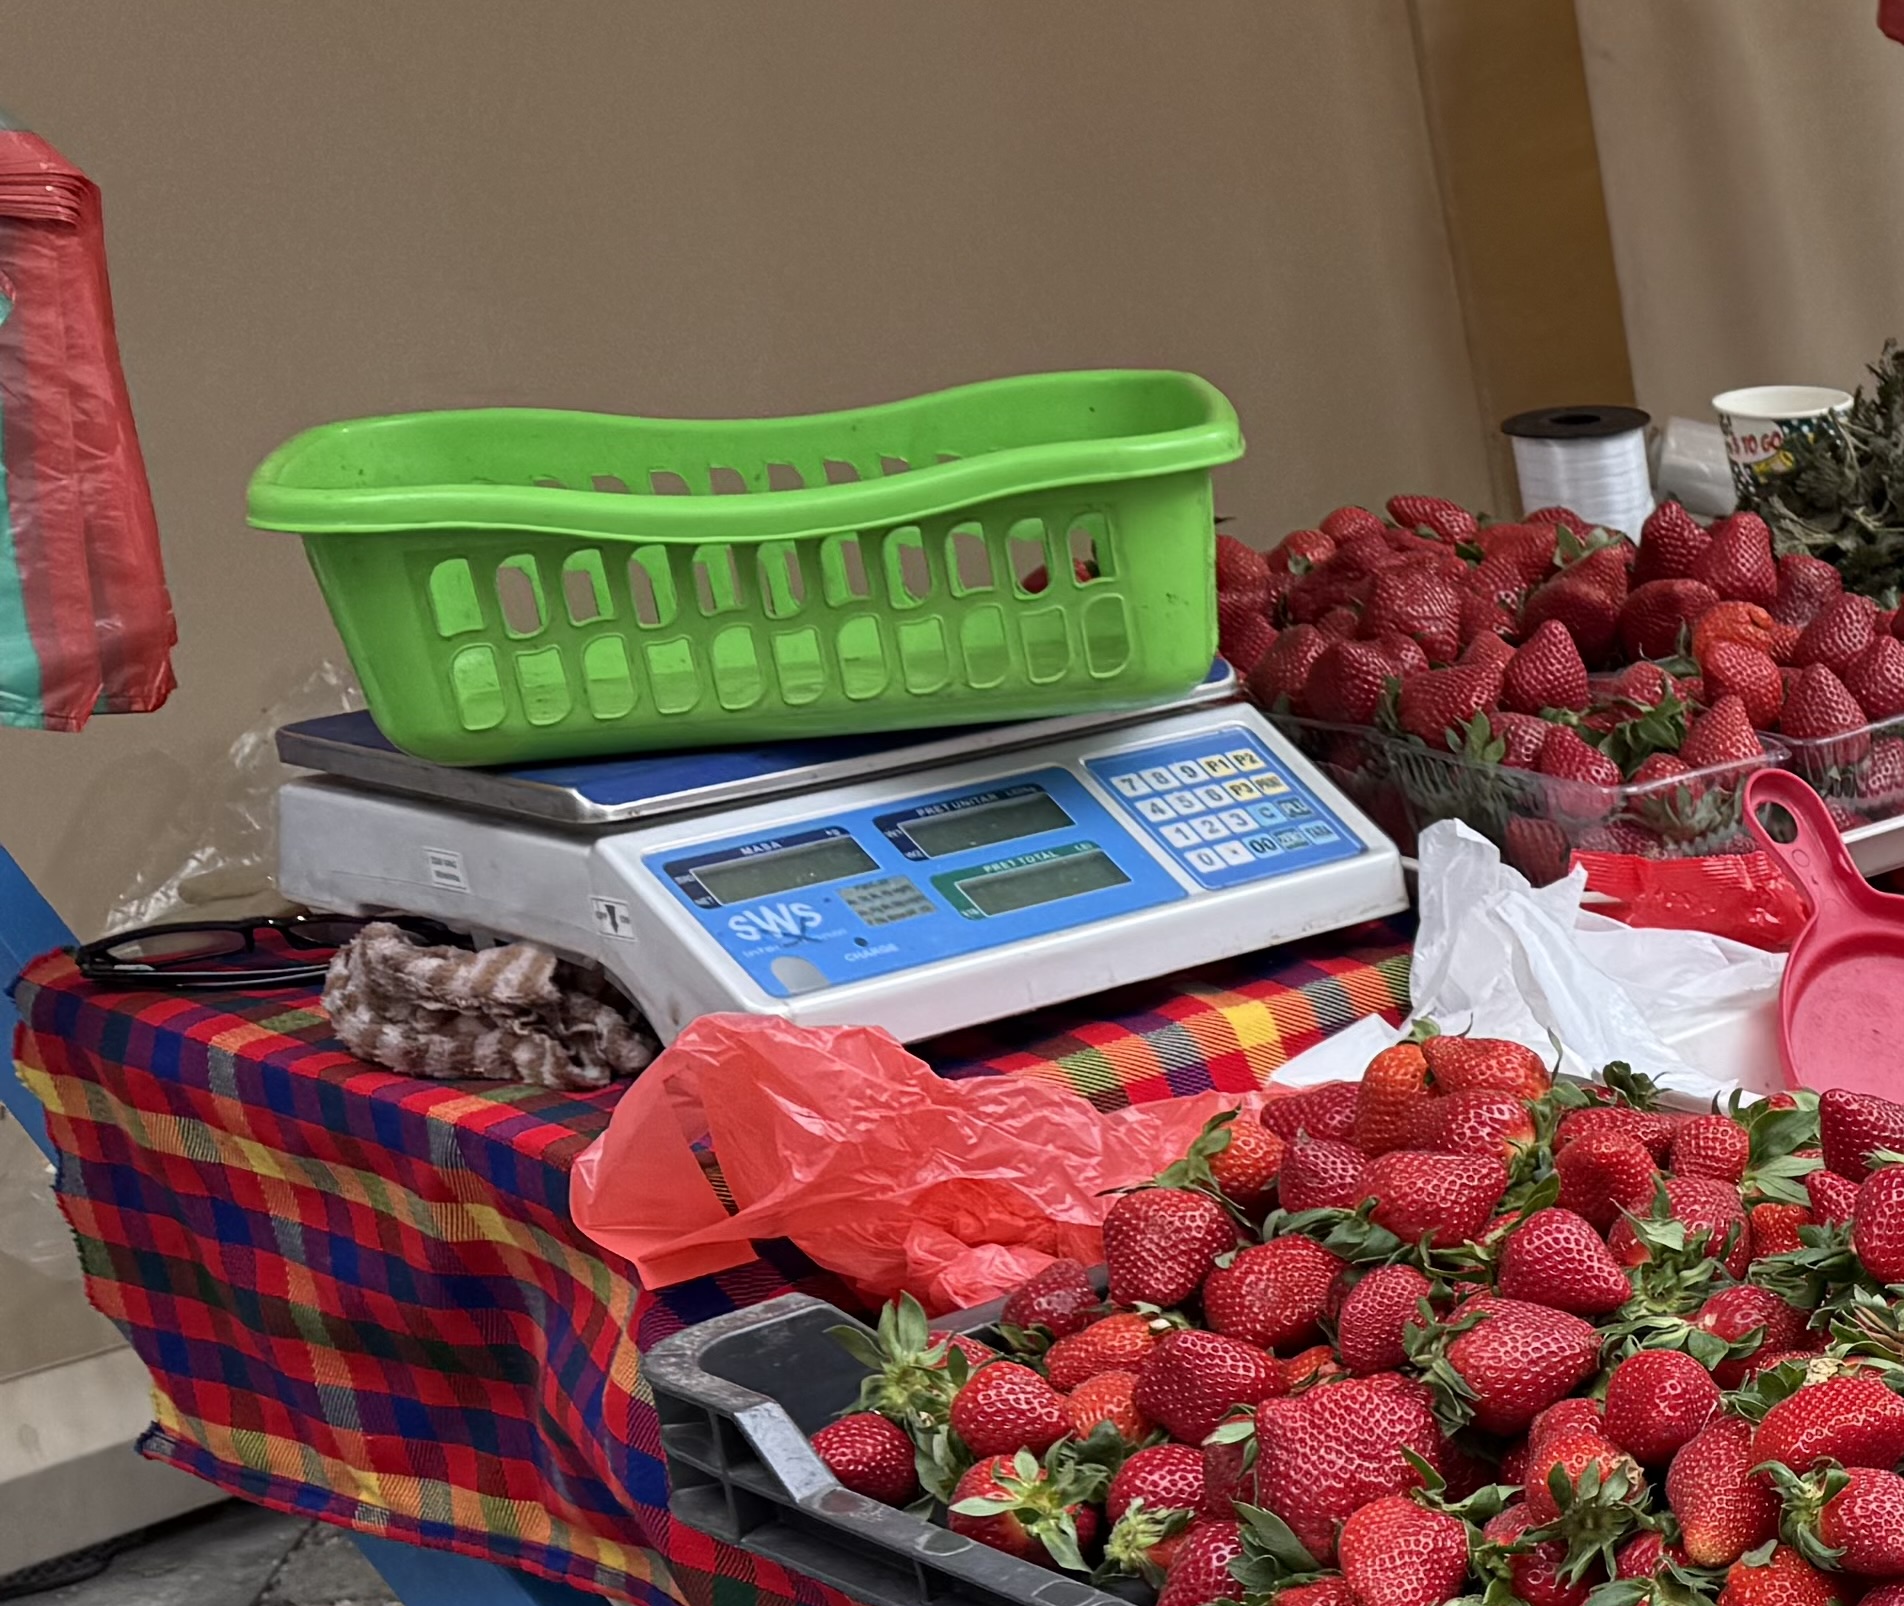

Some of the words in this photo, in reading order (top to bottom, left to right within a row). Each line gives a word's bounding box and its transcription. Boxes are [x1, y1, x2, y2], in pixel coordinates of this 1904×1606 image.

[1741, 433, 1758, 455] TO
[1761, 430, 1782, 453] GO
[1119, 778, 1137, 792] 7
[1150, 771, 1168, 785] 8
[1179, 765, 1197, 779] 9
[1204, 759, 1233, 774] P1
[1232, 752, 1260, 767] P2
[1150, 802, 1167, 816] 4
[1176, 795, 1194, 809] 5
[1209, 788, 1224, 802] 6
[1228, 782, 1256, 798] P3
[1173, 827, 1190, 841] 1
[1200, 820, 1219, 834] 2
[1229, 812, 1248, 827] 3
[1257, 807, 1276, 819] C
[1017, 850, 1060, 866] TOTAL
[1199, 851, 1215, 866] 0
[1249, 837, 1277, 854] 00
[727, 902, 823, 941] SWS
[844, 943, 900, 962] CHARGE
